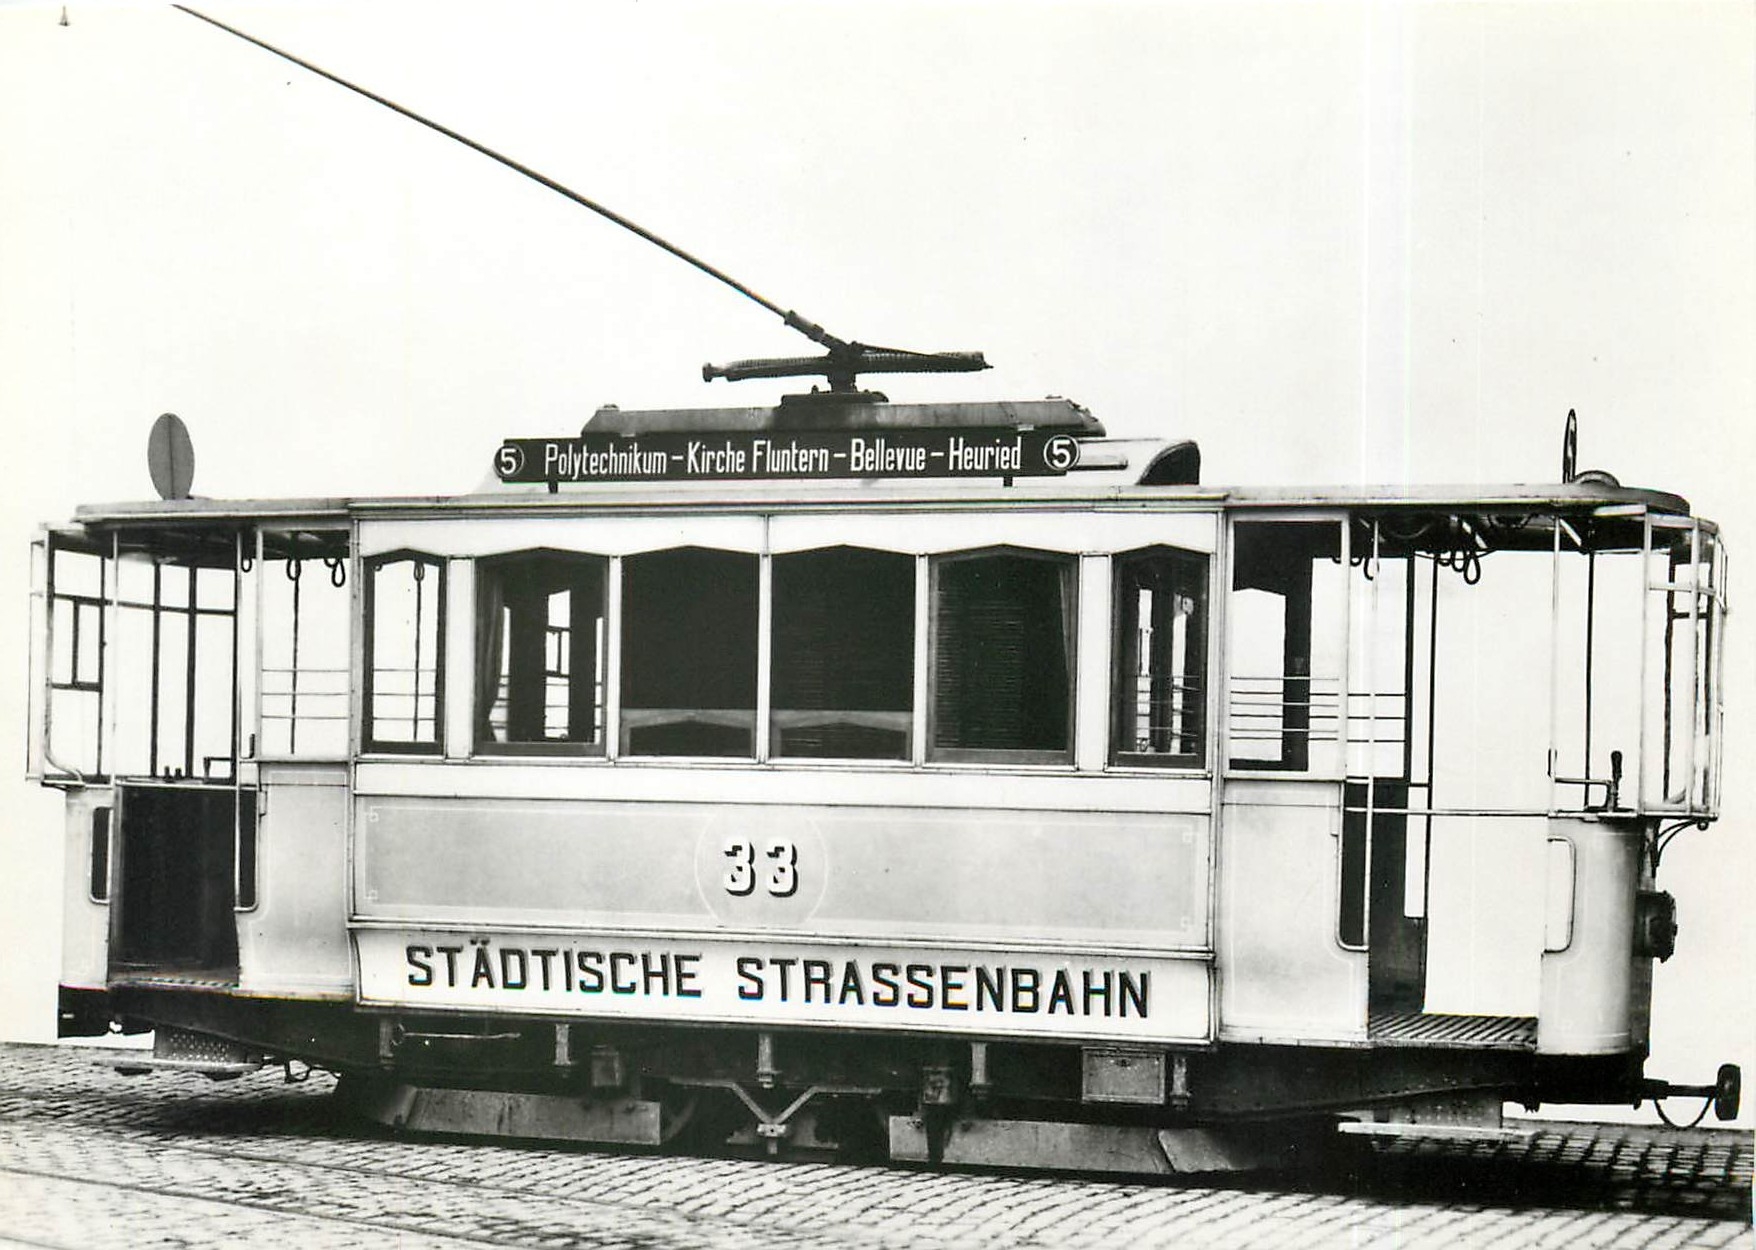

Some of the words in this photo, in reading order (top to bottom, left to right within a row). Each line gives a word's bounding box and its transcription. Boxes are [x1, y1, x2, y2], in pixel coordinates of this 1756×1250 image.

[500, 448, 517, 475] 5
[545, 443, 667, 480] Polytechnikum
[687, 440, 745, 474] Kirche
[752, 439, 829, 473] Fluntern
[850, 437, 926, 473] Bellevue
[949, 435, 1022, 471] Heuried
[1051, 439, 1072, 468] 5
[722, 835, 799, 898] 33
[405, 935, 702, 998] STÄDTISCHE
[736, 956, 1151, 1019] STRASSENBAHN
